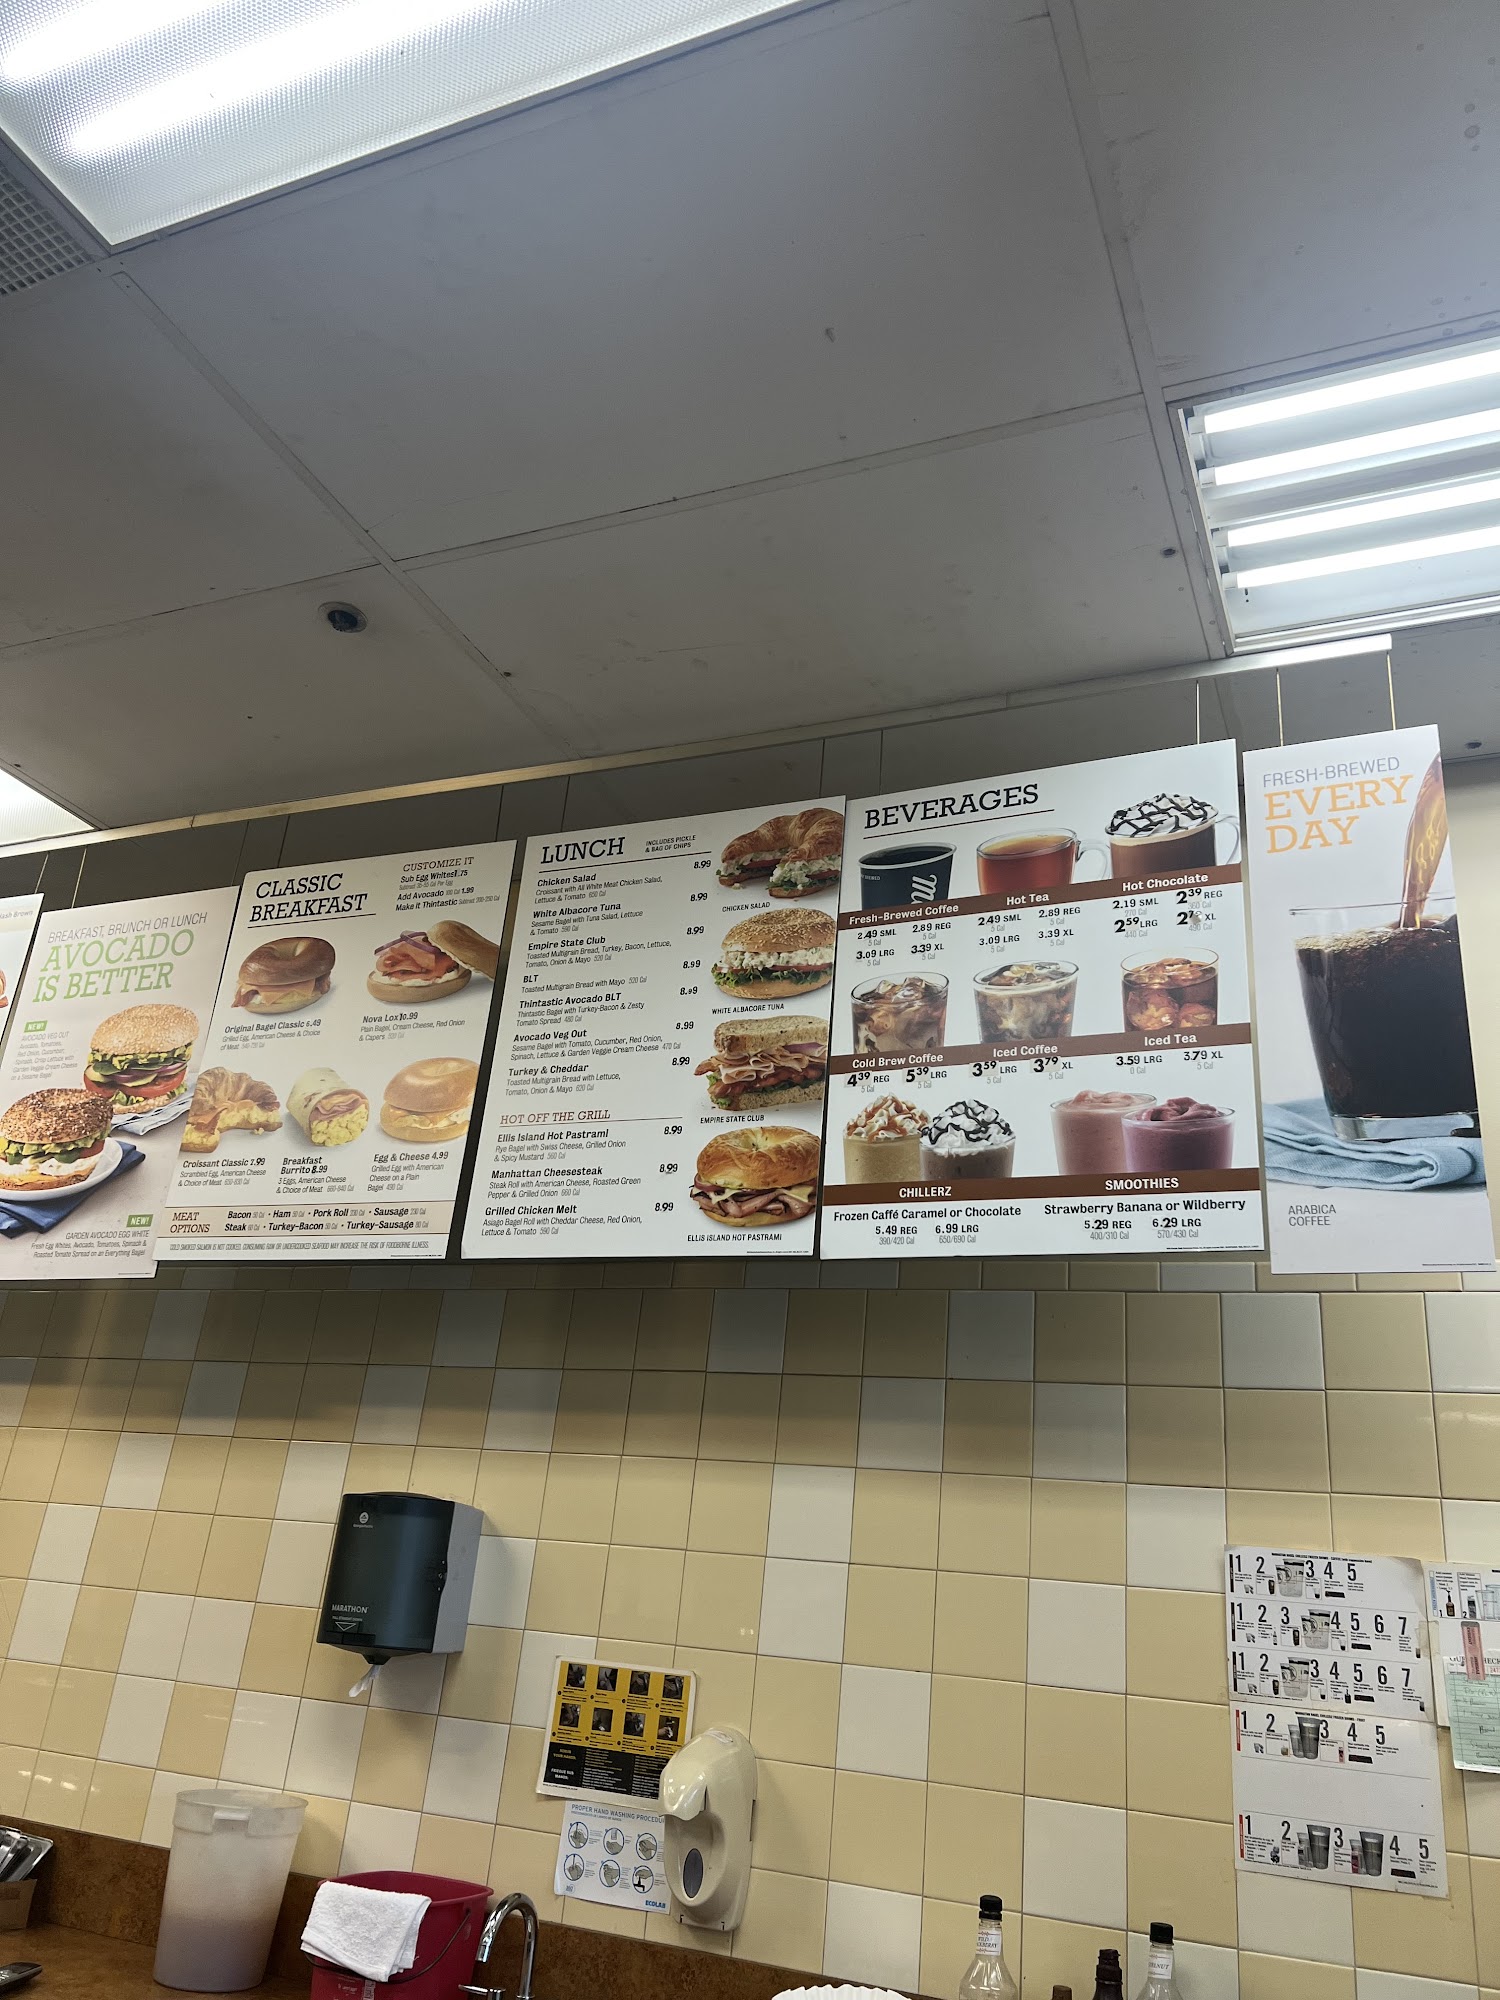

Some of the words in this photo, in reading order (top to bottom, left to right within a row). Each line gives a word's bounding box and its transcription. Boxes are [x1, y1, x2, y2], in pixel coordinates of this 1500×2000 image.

[1263, 757, 1399, 787] FRESH-BREWED
[1264, 775, 1414, 820] EVERY
[865, 784, 1039, 829] BEVERAGES
[1266, 815, 1359, 853] DAY
[541, 837, 625, 864] LUNCH
[403, 858, 461, 872] CUSTOMIZE
[464, 857, 474, 865] IT
[694, 860, 711, 869] 8.99
[256, 873, 343, 898] CLASSIC
[537, 877, 570, 886] Chicken
[573, 874, 596, 882] Salad
[1123, 881, 1144, 891] Hot
[1146, 874, 1208, 888] Chocolate
[397, 893, 411, 901] Add
[413, 890, 444, 899] Avocado
[691, 893, 707, 901] 8.99
[1007, 896, 1026, 905] Hot
[1029, 893, 1049, 902] Tea
[250, 893, 368, 922] BREAKFAST
[396, 903, 414, 911] Make
[423, 899, 457, 908] Thintastic
[533, 910, 556, 918] White
[559, 905, 597, 916] Albacore
[600, 903, 621, 911] Tuna
[849, 909, 922, 925] Fresh-Brewed
[925, 905, 959, 915] Coffee
[1039, 908, 1060, 918] 2.89
[1063, 907, 1081, 915] REG
[48, 925, 104, 944] BREAKFAST,
[108, 920, 150, 935] BRUNCH
[154, 917, 168, 930] OR
[171, 912, 207, 927] LUNCH
[687, 926, 704, 935] 8.99
[913, 924, 932, 933] 2.89
[935, 922, 951, 930] REG
[1038, 929, 1060, 939] 3.39
[528, 941, 558, 951] Empire
[561, 939, 584, 948] State
[587, 936, 605, 945] Club
[979, 936, 1000, 946] 3.09
[1003, 935, 1020, 943] LRG
[40, 929, 194, 972] AVOCADO
[683, 960, 701, 969] 8.99
[32, 973, 60, 1002] IS
[64, 962, 174, 1000] BETTER
[523, 975, 538, 983] BLT
[680, 986, 698, 995] 8.99
[520, 998, 563, 1009] Thintastic
[565, 995, 603, 1004] Avocado
[605, 993, 621, 1002] BLT
[733, 1005, 766, 1013] ALBACORE
[225, 1024, 254, 1034] Original
[256, 1023, 276, 1032] Bagel
[278, 1021, 304, 1029] Classic
[676, 1021, 694, 1030] 8.99
[514, 1032, 550, 1042] Avocado
[554, 1031, 568, 1040] Veg
[1145, 1035, 1170, 1046] Iced
[1174, 1034, 1197, 1044] Tea
[993, 1048, 1017, 1057] Iced
[1021, 1044, 1058, 1055] Coffee
[672, 1057, 690, 1066] 8.99
[852, 1059, 875, 1069] Cold
[878, 1057, 905, 1067] Brew
[908, 1054, 944, 1064] Coffee
[508, 1068, 538, 1076] Turkey
[541, 1066, 547, 1074] &
[550, 1064, 588, 1073] Cheddar
[501, 1115, 524, 1124] HOT
[528, 1113, 549, 1122] OFF
[552, 1112, 574, 1121] THE
[578, 1110, 610, 1119] GRILL
[700, 1116, 724, 1124] EMPIRE
[498, 1133, 515, 1142] Ellis
[518, 1132, 545, 1141] Island
[547, 1132, 563, 1140] Hot
[565, 1129, 609, 1139] Pastrami
[664, 1126, 682, 1135] 8.99
[283, 1156, 322, 1165] Breakfast
[374, 1154, 388, 1163] Egg
[390, 1153, 397, 1161] &
[400, 1153, 430, 1161] Cheese
[432, 1151, 448, 1159] 4.99
[183, 1160, 219, 1168] Croissant
[221, 1158, 248, 1167] Classic
[660, 1164, 678, 1173] 8.99
[281, 1166, 310, 1175] Burrito
[311, 1165, 328, 1174] 8.99
[492, 1169, 541, 1179] Manhattan
[544, 1166, 602, 1176] Cheesesteak
[1105, 1178, 1179, 1191] SMOOTHIES
[900, 1186, 951, 1198] CHILLERZ
[485, 1207, 515, 1216] Grilled
[518, 1205, 554, 1214] Chicken
[556, 1205, 577, 1213] Melt
[655, 1203, 673, 1211] 8.99
[1044, 1203, 1113, 1214] Strawberry
[1117, 1202, 1162, 1211] Banana
[1166, 1202, 1180, 1210] or
[1183, 1199, 1245, 1210] Wildberry
[1288, 1204, 1336, 1215] ARABICA
[172, 1212, 199, 1221] MEAT
[228, 1211, 251, 1219] Bacon
[273, 1210, 291, 1218] Ham
[334, 1208, 348, 1216] Roll
[374, 1208, 408, 1217] Sausage
[834, 1212, 869, 1221] Frozen
[871, 1209, 899, 1220] Caffé
[901, 1207, 947, 1219] Caramel
[965, 1206, 1021, 1216] Chocolate
[130, 1217, 149, 1225] NEW!
[225, 1223, 246, 1231] Steak
[268, 1222, 323, 1232] Turkey-Bacon
[347, 1221, 414, 1230] Turkey-Sausage
[1084, 1220, 1108, 1229] 5.29
[1112, 1221, 1132, 1229] REG
[1153, 1218, 1177, 1228] 6.29
[1182, 1219, 1201, 1227] LRG
[1289, 1216, 1331, 1226] COFFEE
[170, 1224, 210, 1233] OPTIONS
[875, 1226, 897, 1235] 5.49
[900, 1226, 917, 1234] REG
[935, 1224, 958, 1234] 6.99
[962, 1225, 978, 1233] LRG
[90, 1231, 117, 1239] AVOCADO
[332, 1604, 368, 1613] MARATHON
[572, 1804, 592, 1812] PROPER
[594, 1807, 609, 1815] HAND
[610, 1809, 635, 1819] WASHING
[1245, 1815, 1250, 1834] 1
[1282, 1821, 1291, 1841] 2
[1334, 1827, 1344, 1847] 3
[1390, 1836, 1400, 1855] 4
[1419, 1839, 1429, 1859] 5
[646, 1900, 665, 1908] ECOLAB
